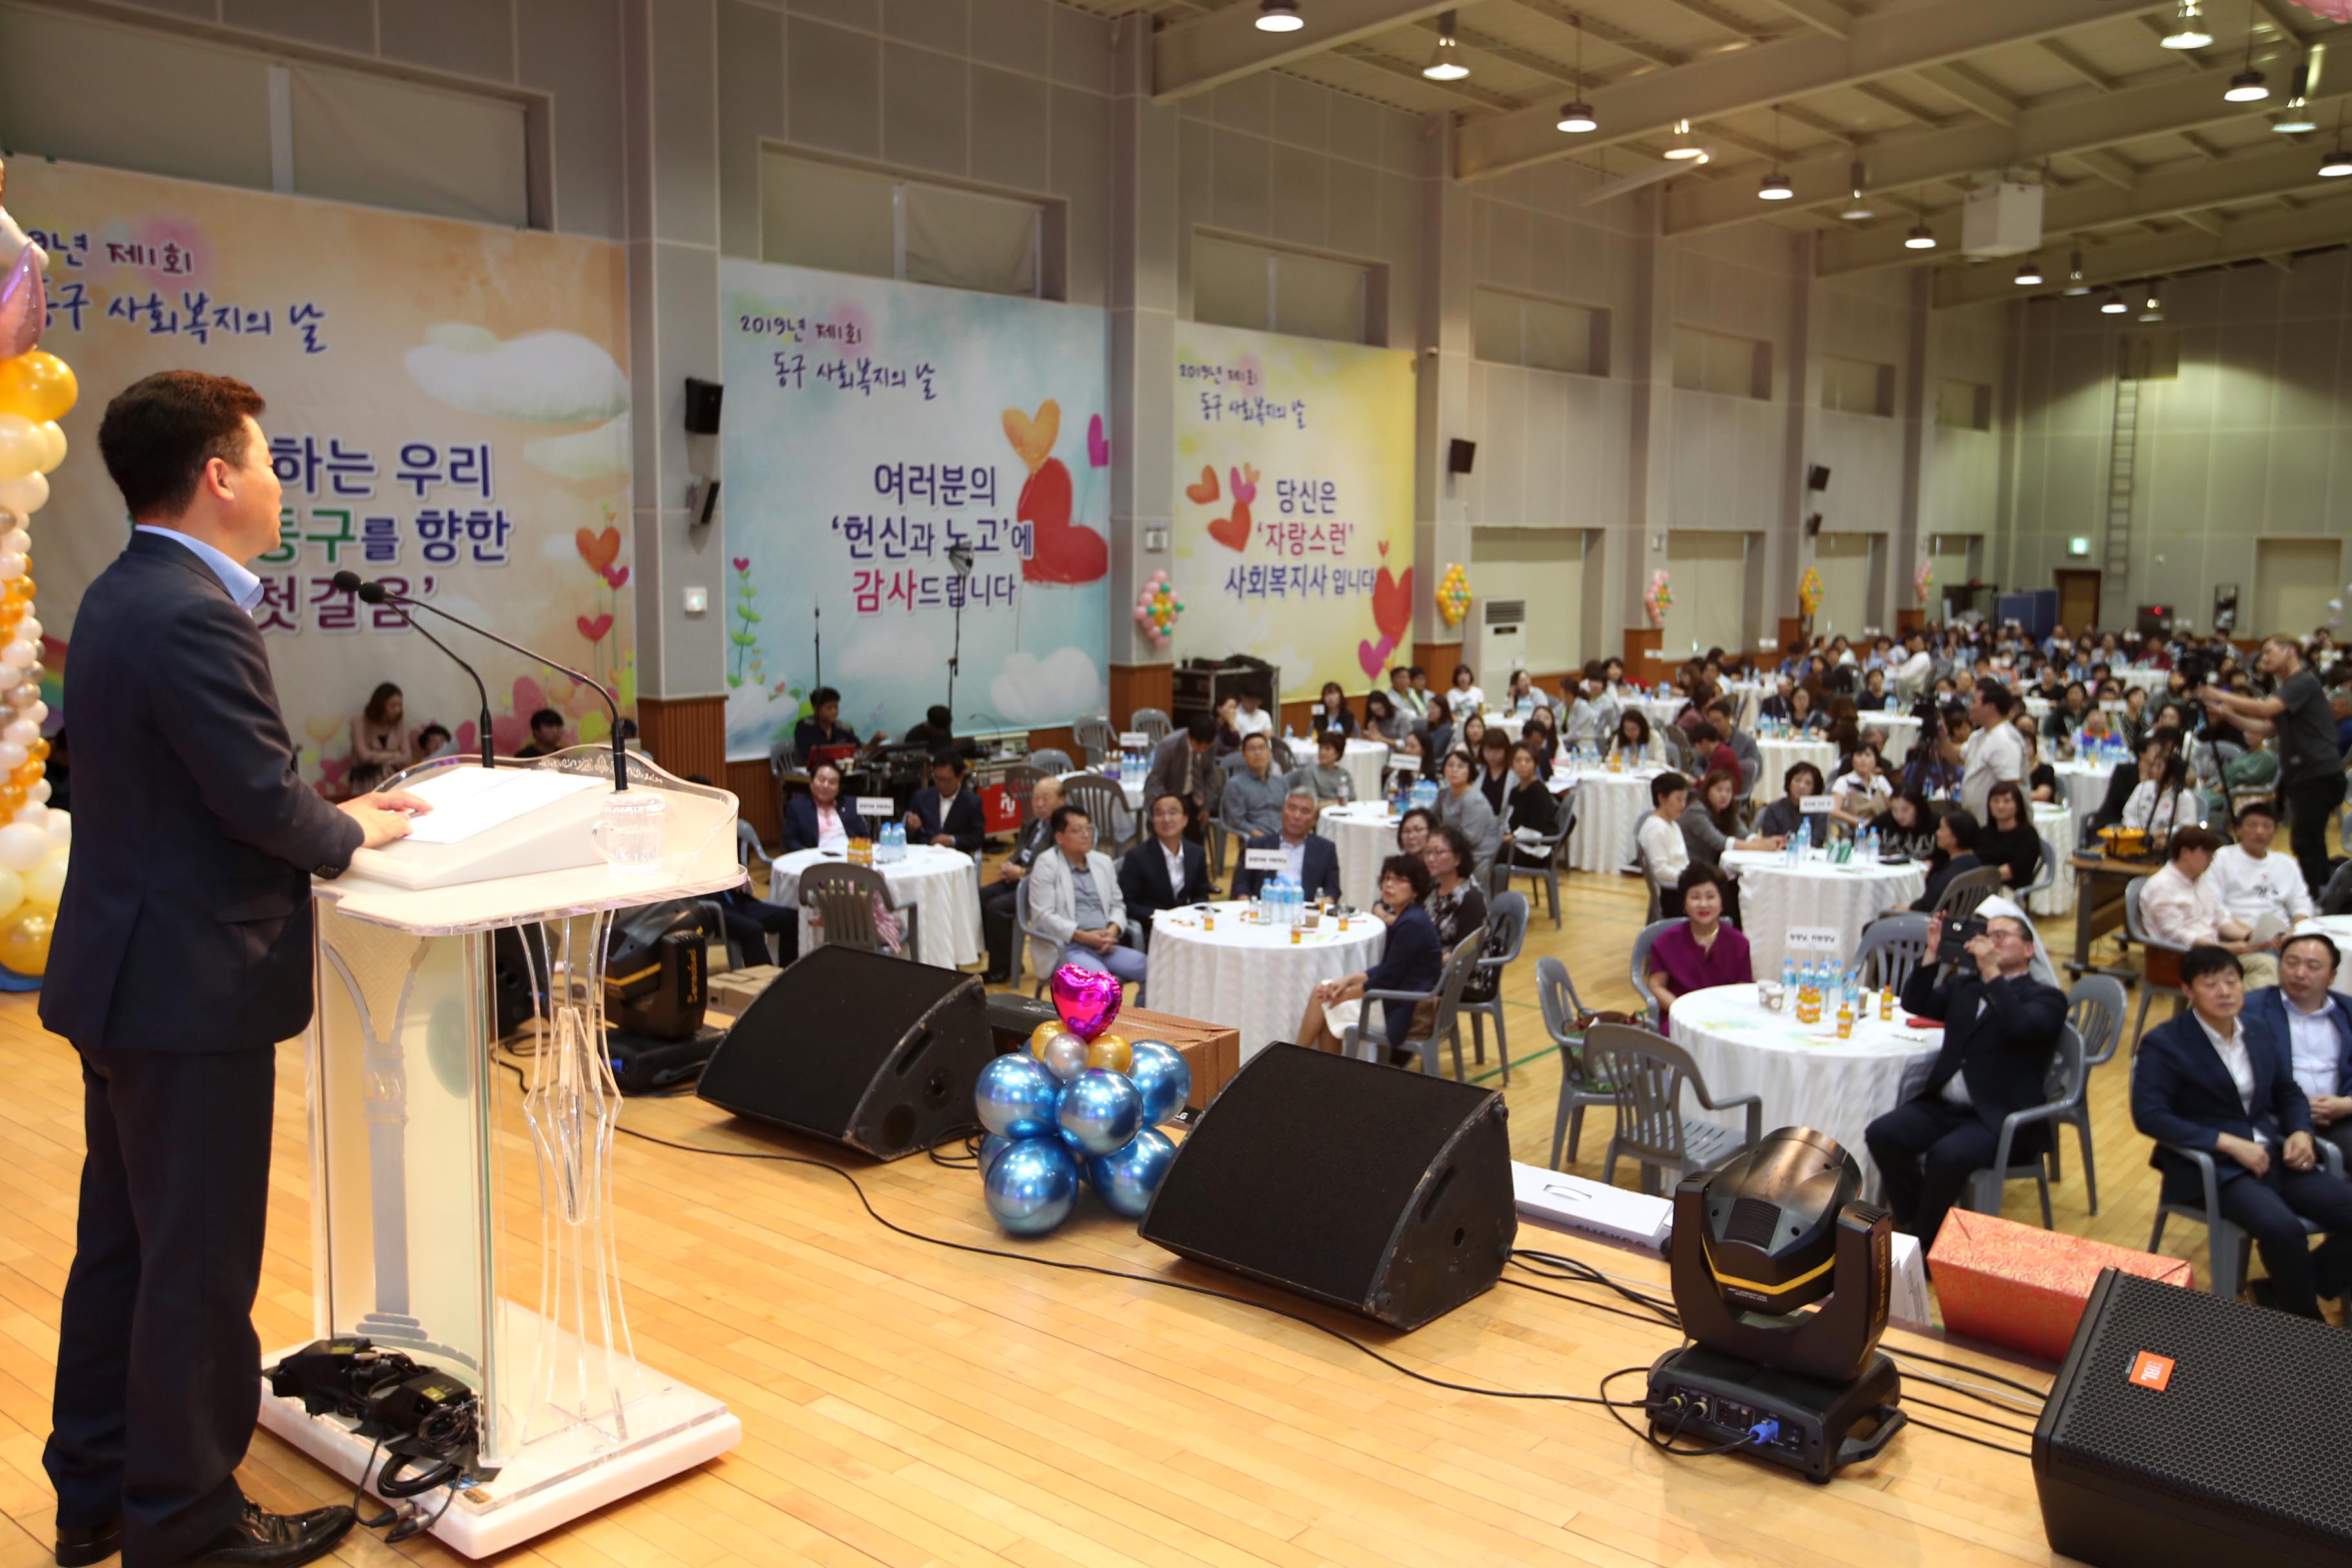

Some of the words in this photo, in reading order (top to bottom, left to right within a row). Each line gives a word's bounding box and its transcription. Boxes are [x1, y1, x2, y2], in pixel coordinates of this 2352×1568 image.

[106, 242, 193, 274] 제1회
[108, 292, 272, 344] 사회복지의
[290, 303, 326, 354] 날
[740, 315, 805, 342] 2019년
[816, 321, 861, 344] 제1회
[774, 351, 806, 389] 동구
[817, 357, 906, 396] 사회복지의
[916, 362, 936, 400] 날
[1178, 364, 1222, 385] 2019년
[1199, 391, 1222, 421] 동구
[1228, 396, 1287, 427] 사회복지의
[397, 444, 490, 498] 우리
[874, 462, 995, 507] 여러분의
[1276, 478, 1337, 514] 당신은
[416, 509, 511, 562] 향한
[852, 568, 1017, 613] 감사드립니다
[2141, 1360, 2164, 1381] JBL
